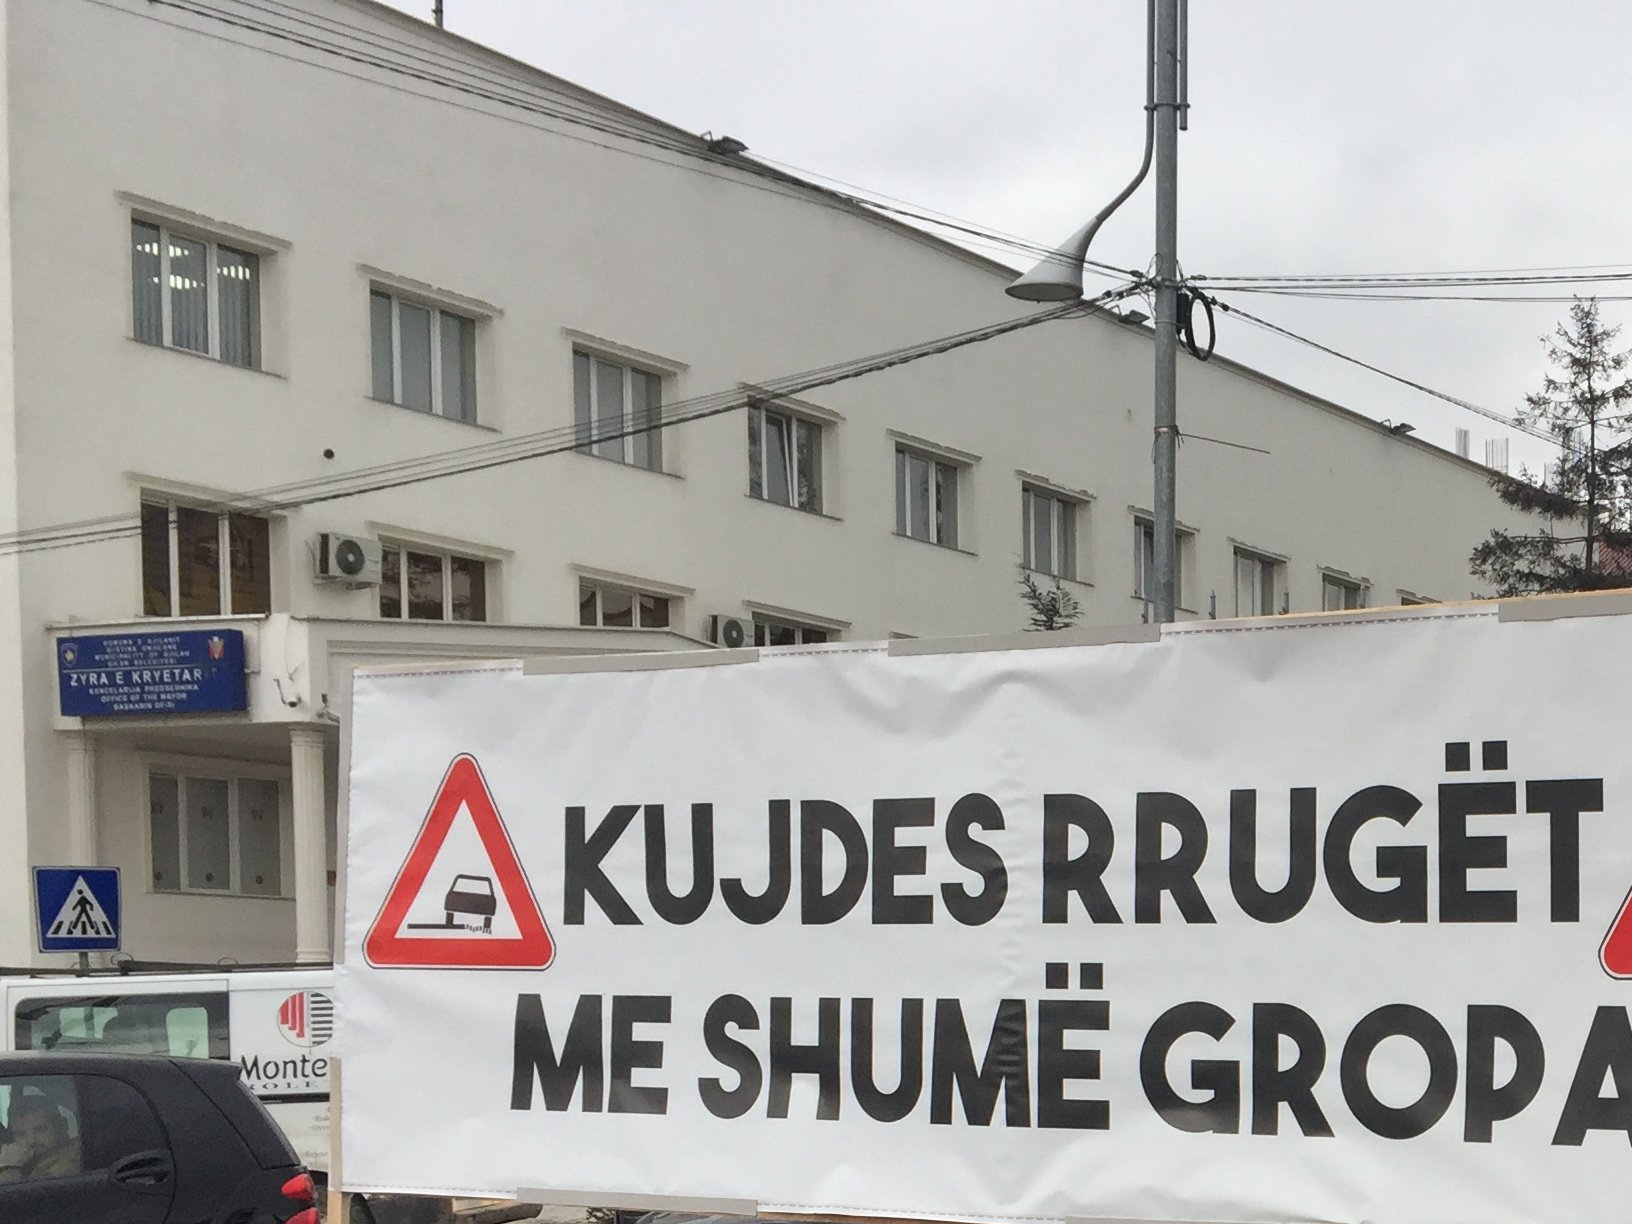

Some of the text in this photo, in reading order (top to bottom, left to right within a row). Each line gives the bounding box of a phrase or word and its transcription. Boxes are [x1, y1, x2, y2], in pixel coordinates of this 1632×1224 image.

[70, 672, 109, 686] ZYRA
[115, 672, 124, 683] E
[563, 740, 1604, 926] KUJDES RRUGËT
[511, 994, 671, 1114] ME
[698, 961, 1111, 1130] SHUMË
